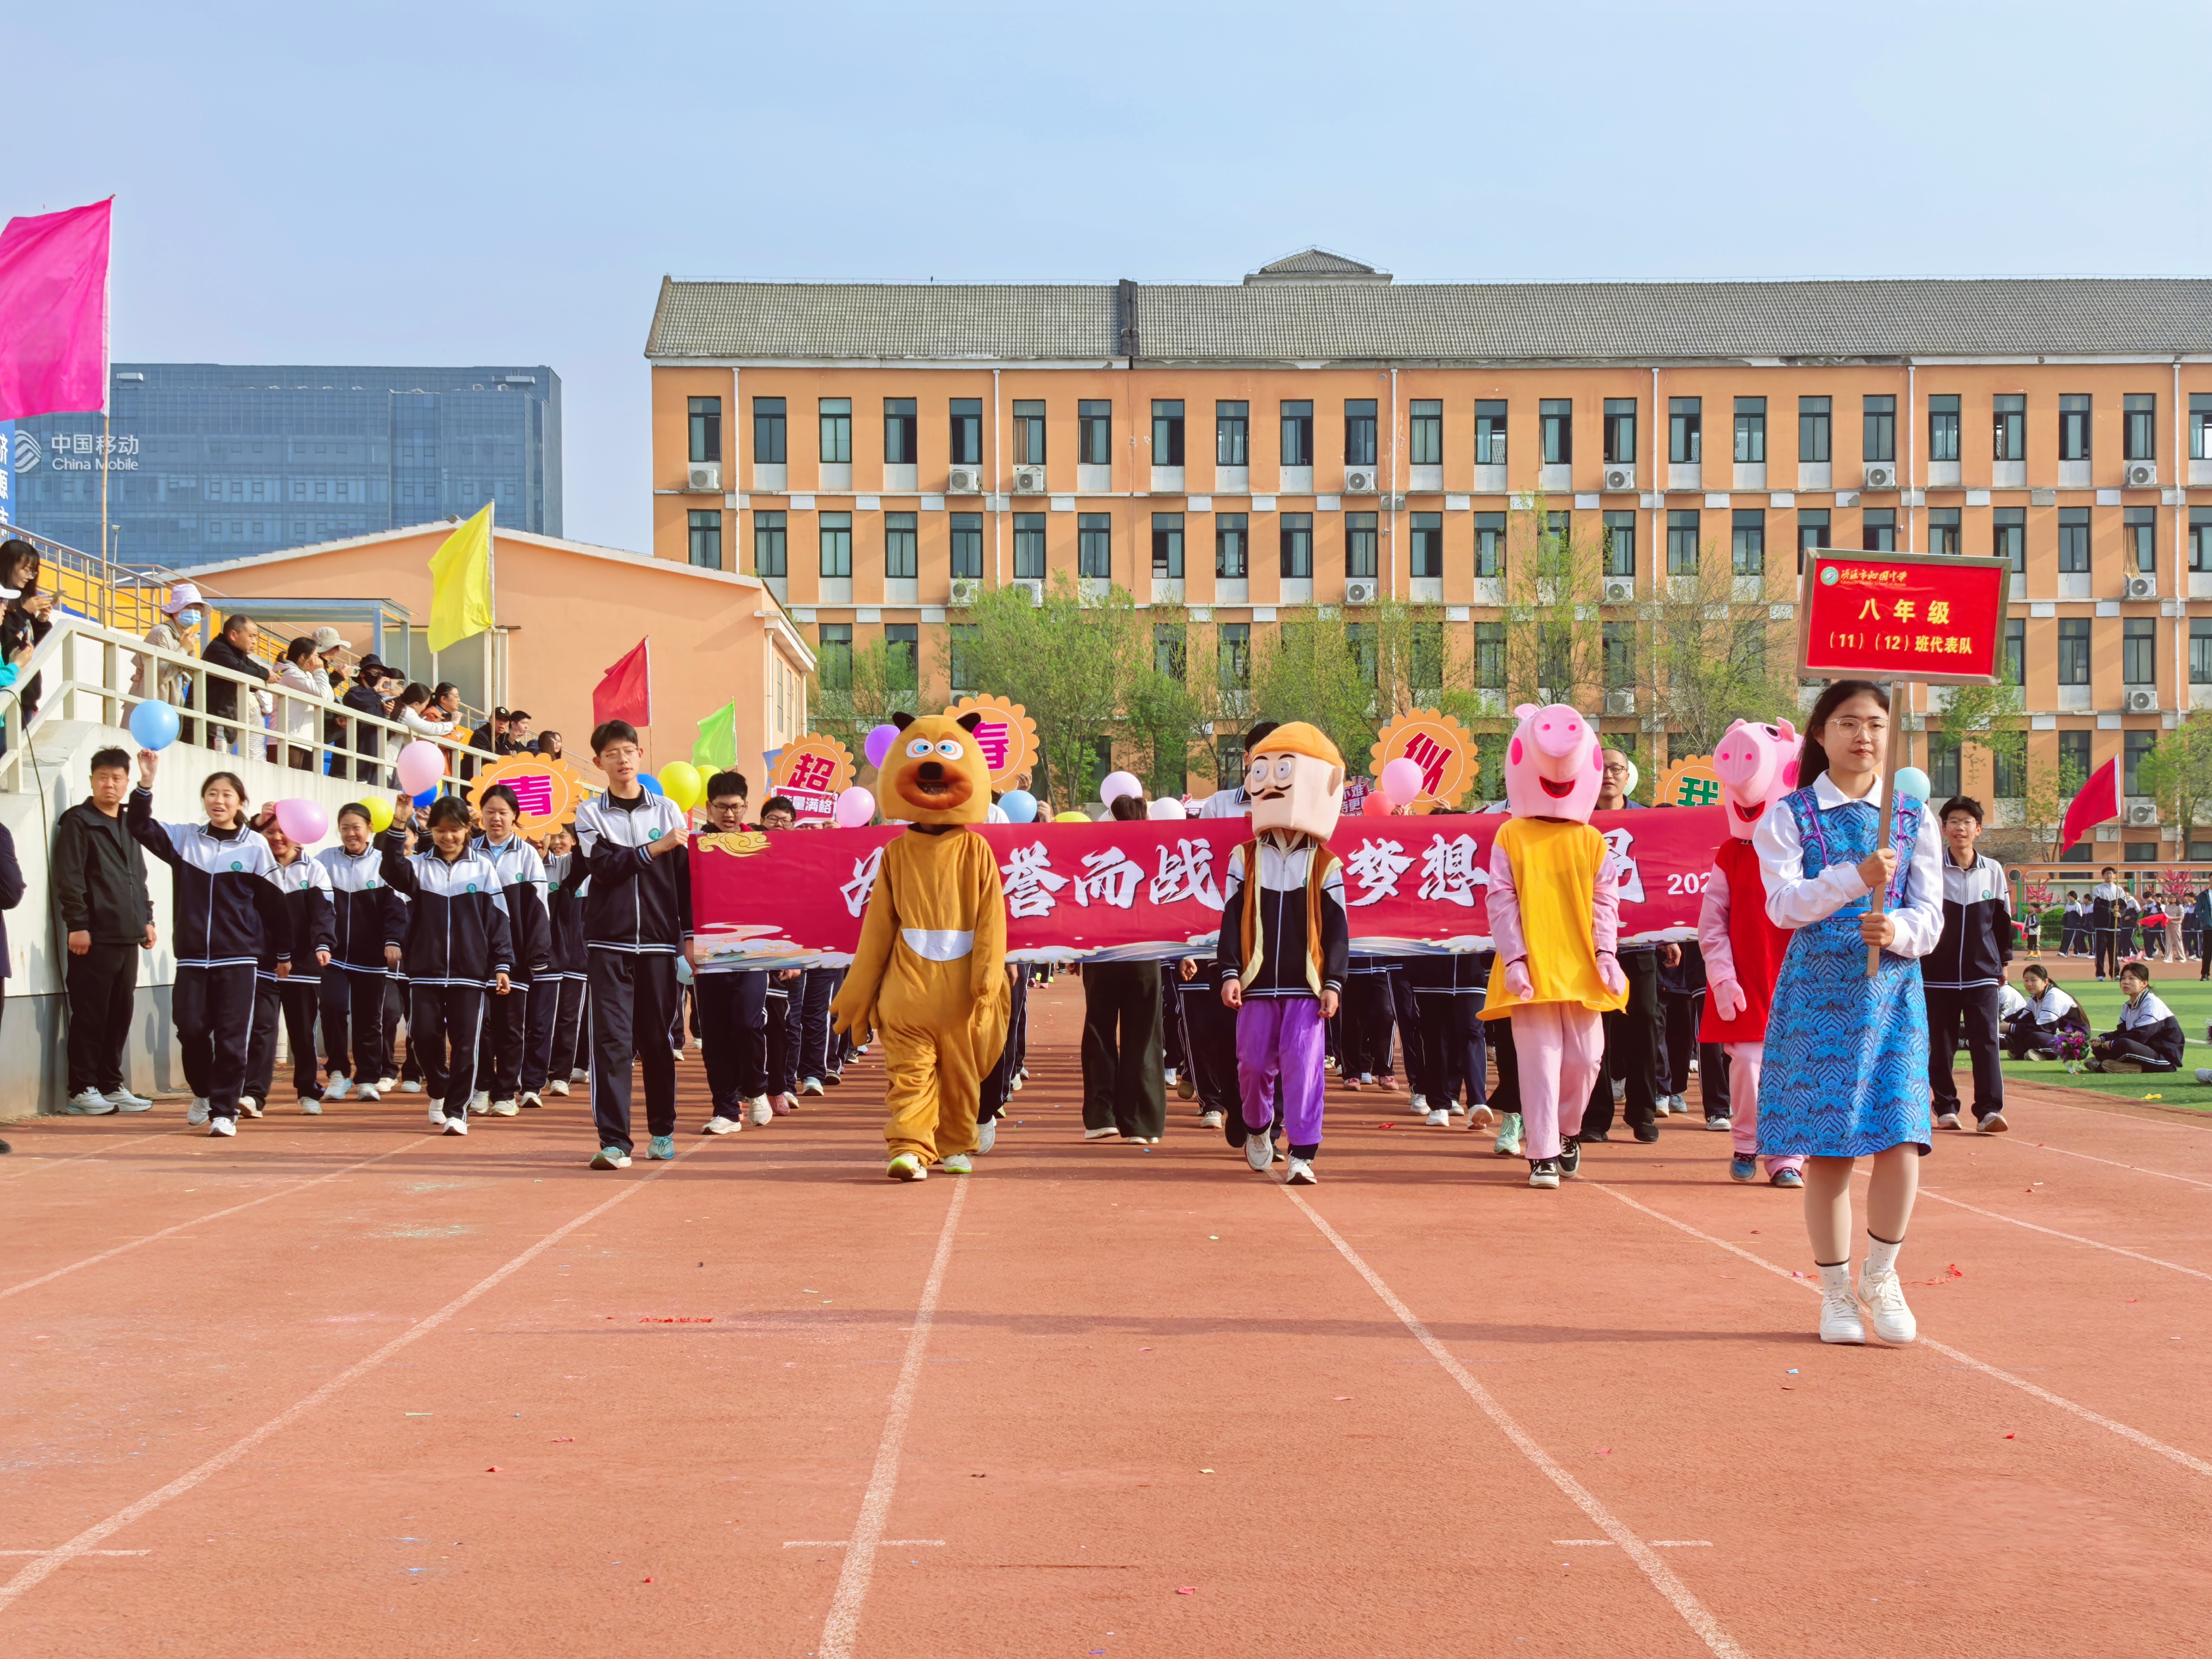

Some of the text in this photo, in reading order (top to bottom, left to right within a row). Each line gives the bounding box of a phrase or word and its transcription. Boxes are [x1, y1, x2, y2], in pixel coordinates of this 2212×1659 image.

[51, 433, 139, 455] 中国移动
[52, 457, 139, 470] China Mobile
[1858, 598, 1950, 624] 八年级
[786, 752, 837, 792] 超
[497, 774, 553, 818] 青
[1677, 776, 1719, 806] 我
